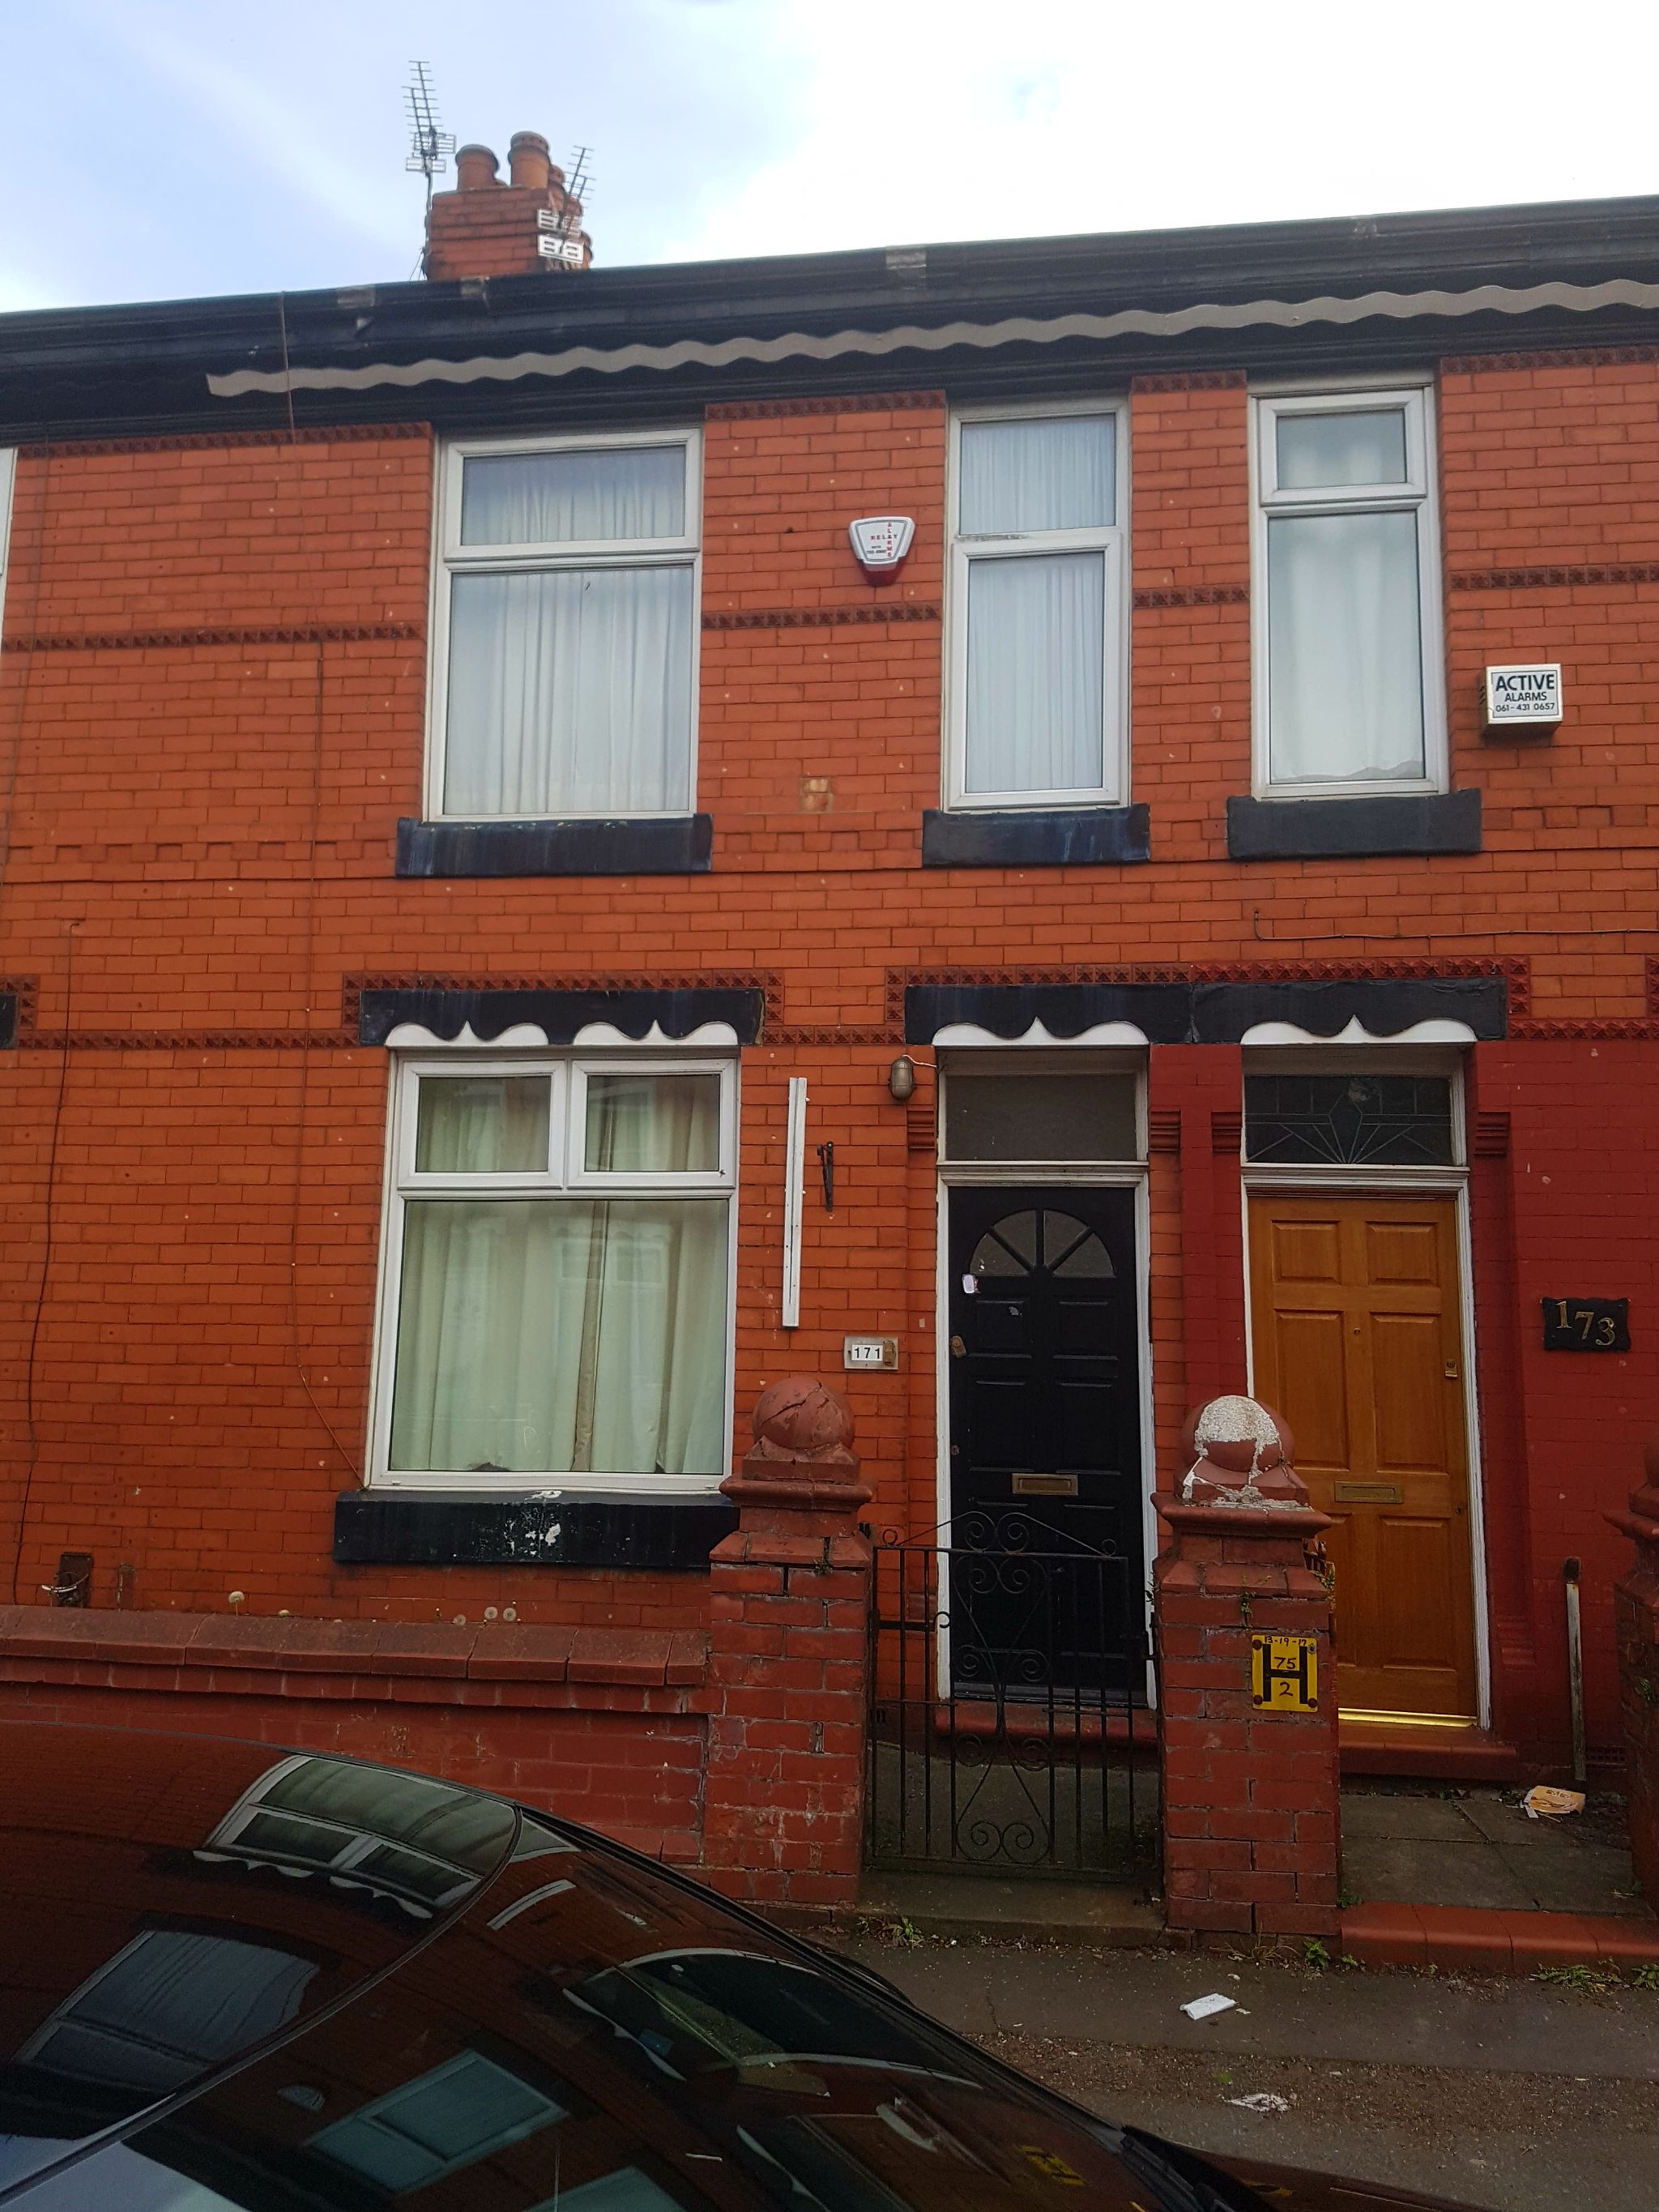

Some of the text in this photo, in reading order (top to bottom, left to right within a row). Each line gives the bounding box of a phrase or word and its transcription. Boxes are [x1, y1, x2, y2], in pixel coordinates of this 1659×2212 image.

[1495, 673, 1555, 691] ACTIVE
[1505, 691, 1547, 702] ALARMS
[1533, 702, 1555, 711] 0657
[1555, 1300, 1615, 1346] 173
[854, 1347, 880, 1359] 171
[1274, 1656, 1297, 1669] 75
[1279, 1681, 1294, 1697] 2
